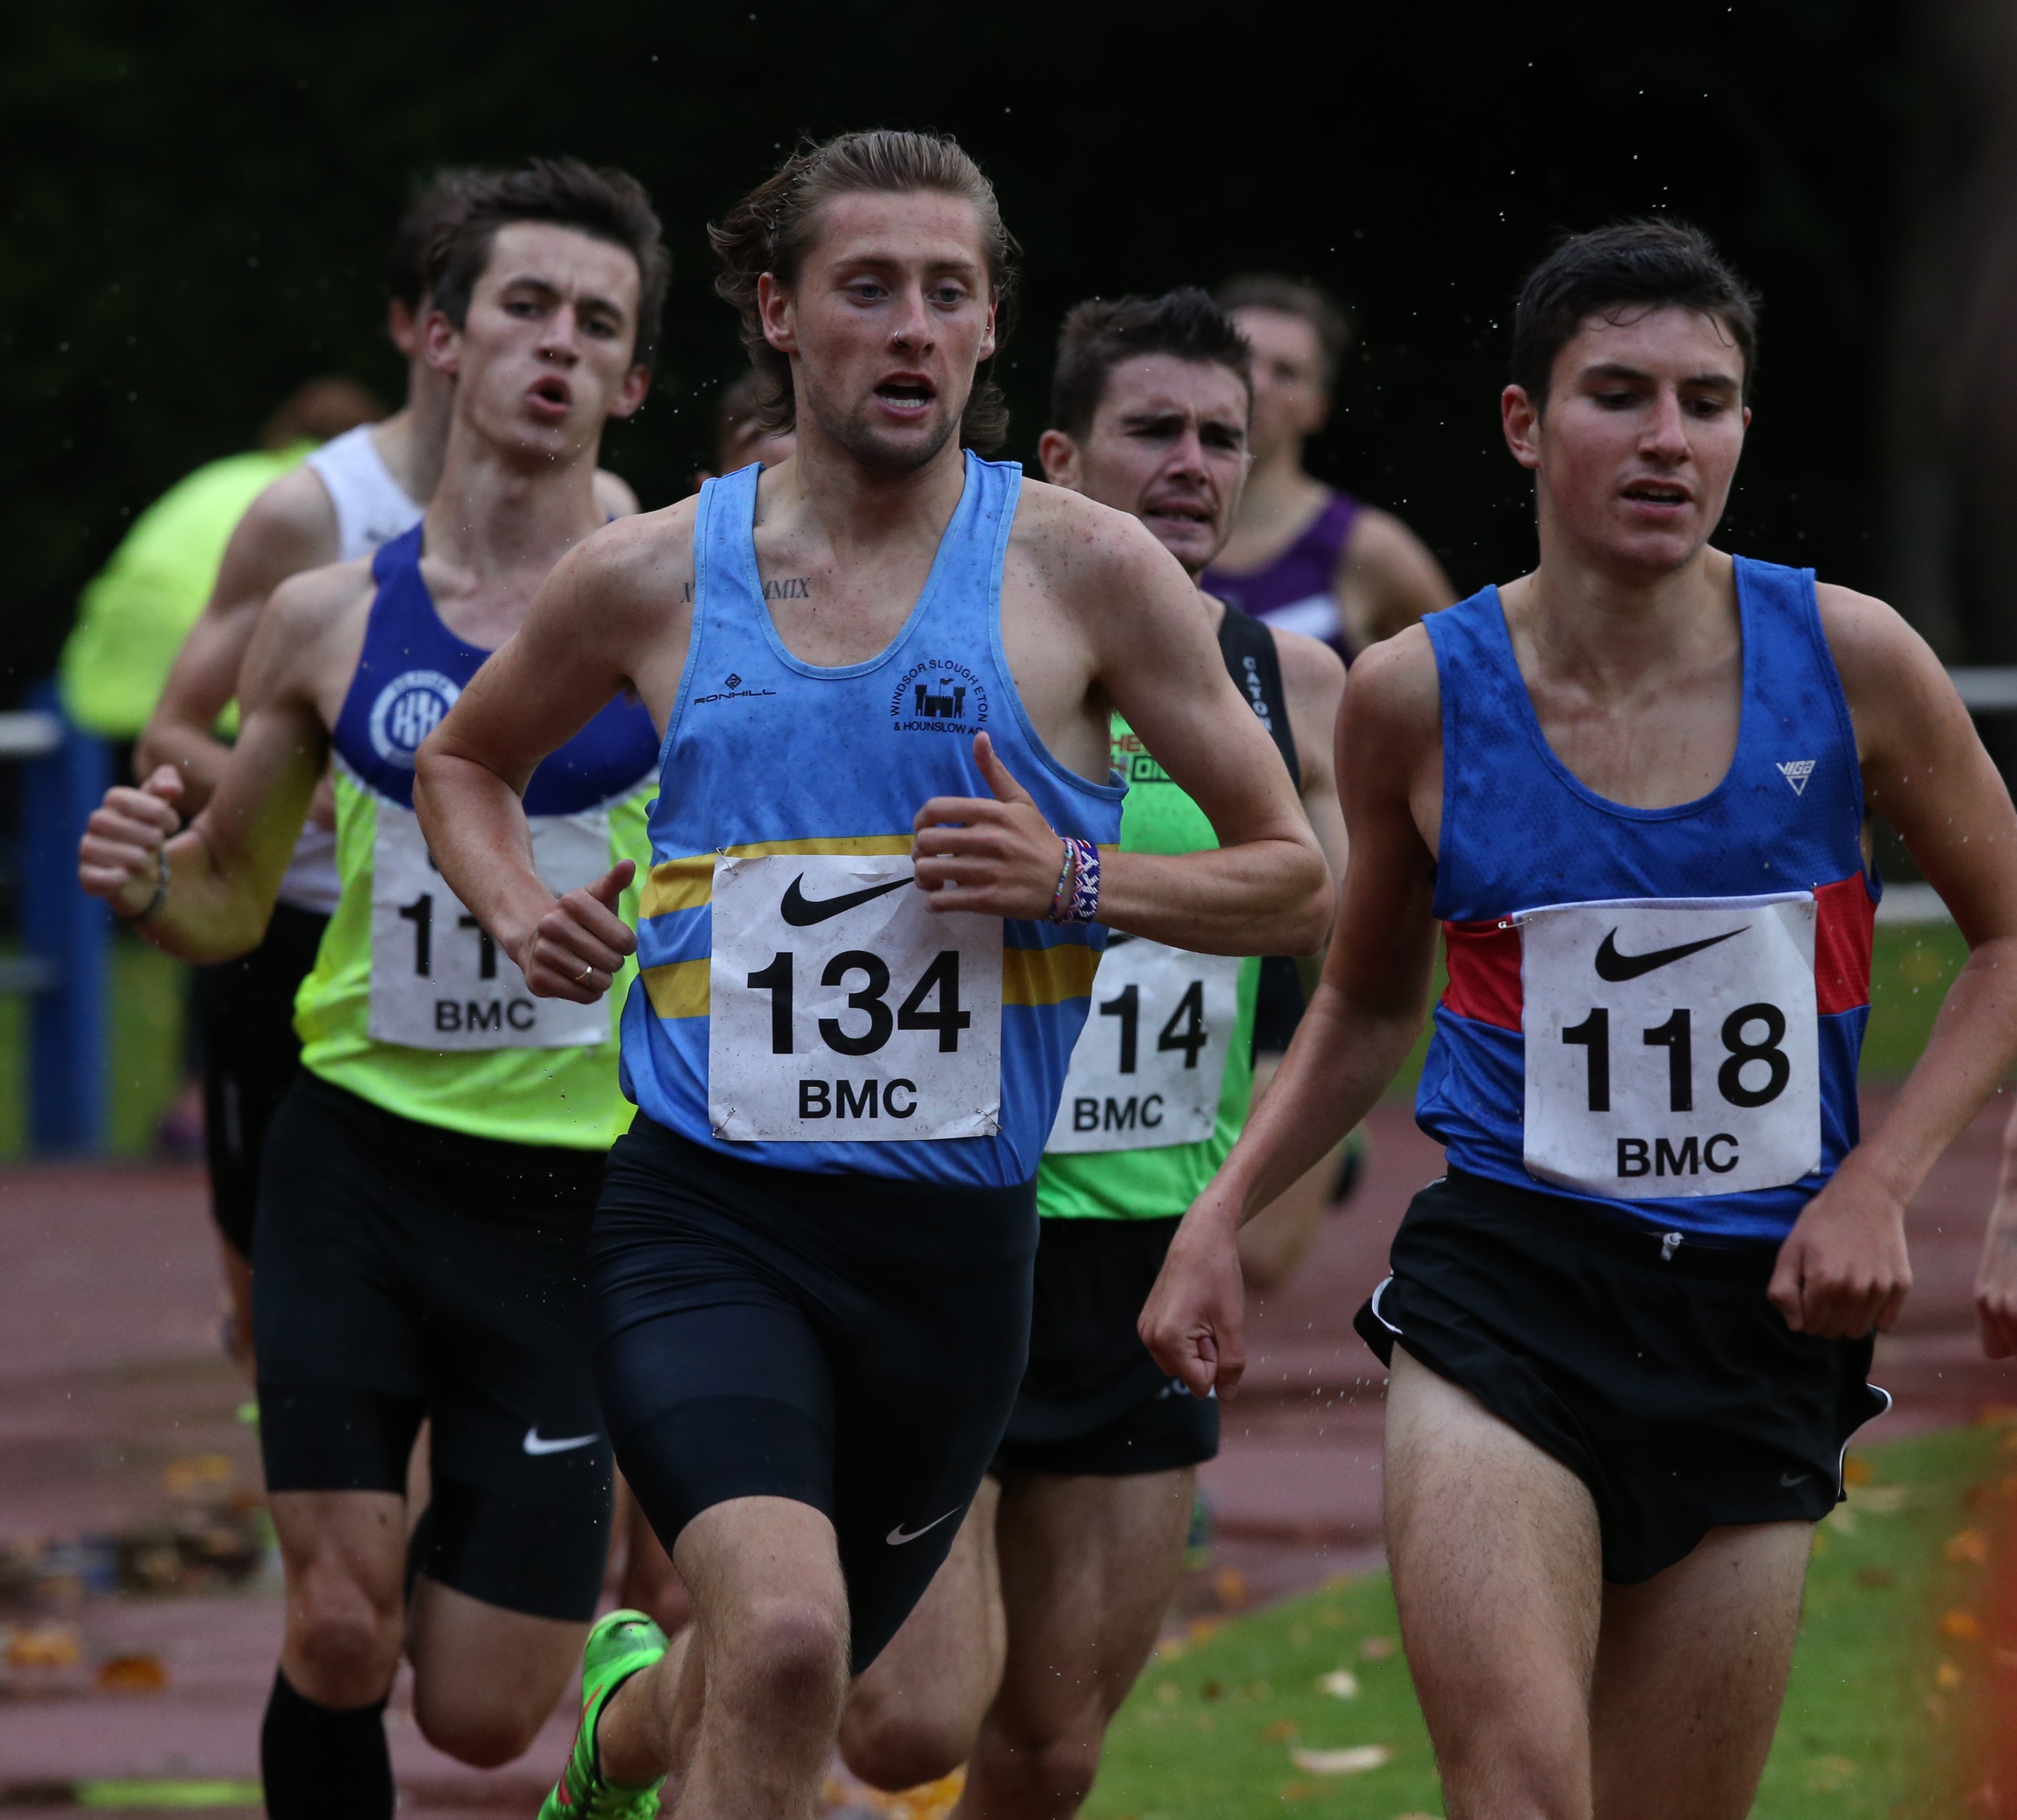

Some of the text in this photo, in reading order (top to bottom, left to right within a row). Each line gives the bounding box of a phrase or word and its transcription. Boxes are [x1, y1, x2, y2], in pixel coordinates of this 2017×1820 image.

[693, 689, 776, 706] RONHILL
[891, 659, 988, 723] WINDSOR SLOUGH ETON
[893, 721, 901, 731] &
[903, 721, 966, 734] HOUNSLOW
[435, 998, 536, 1032] BMC
[747, 949, 971, 1057] 134
[1099, 979, 1208, 1074] 14
[1561, 1002, 1791, 1112] 118
[798, 1078, 918, 1119] BMC
[1073, 1094, 1164, 1132] BMC
[1616, 1133, 1740, 1178] BMC
